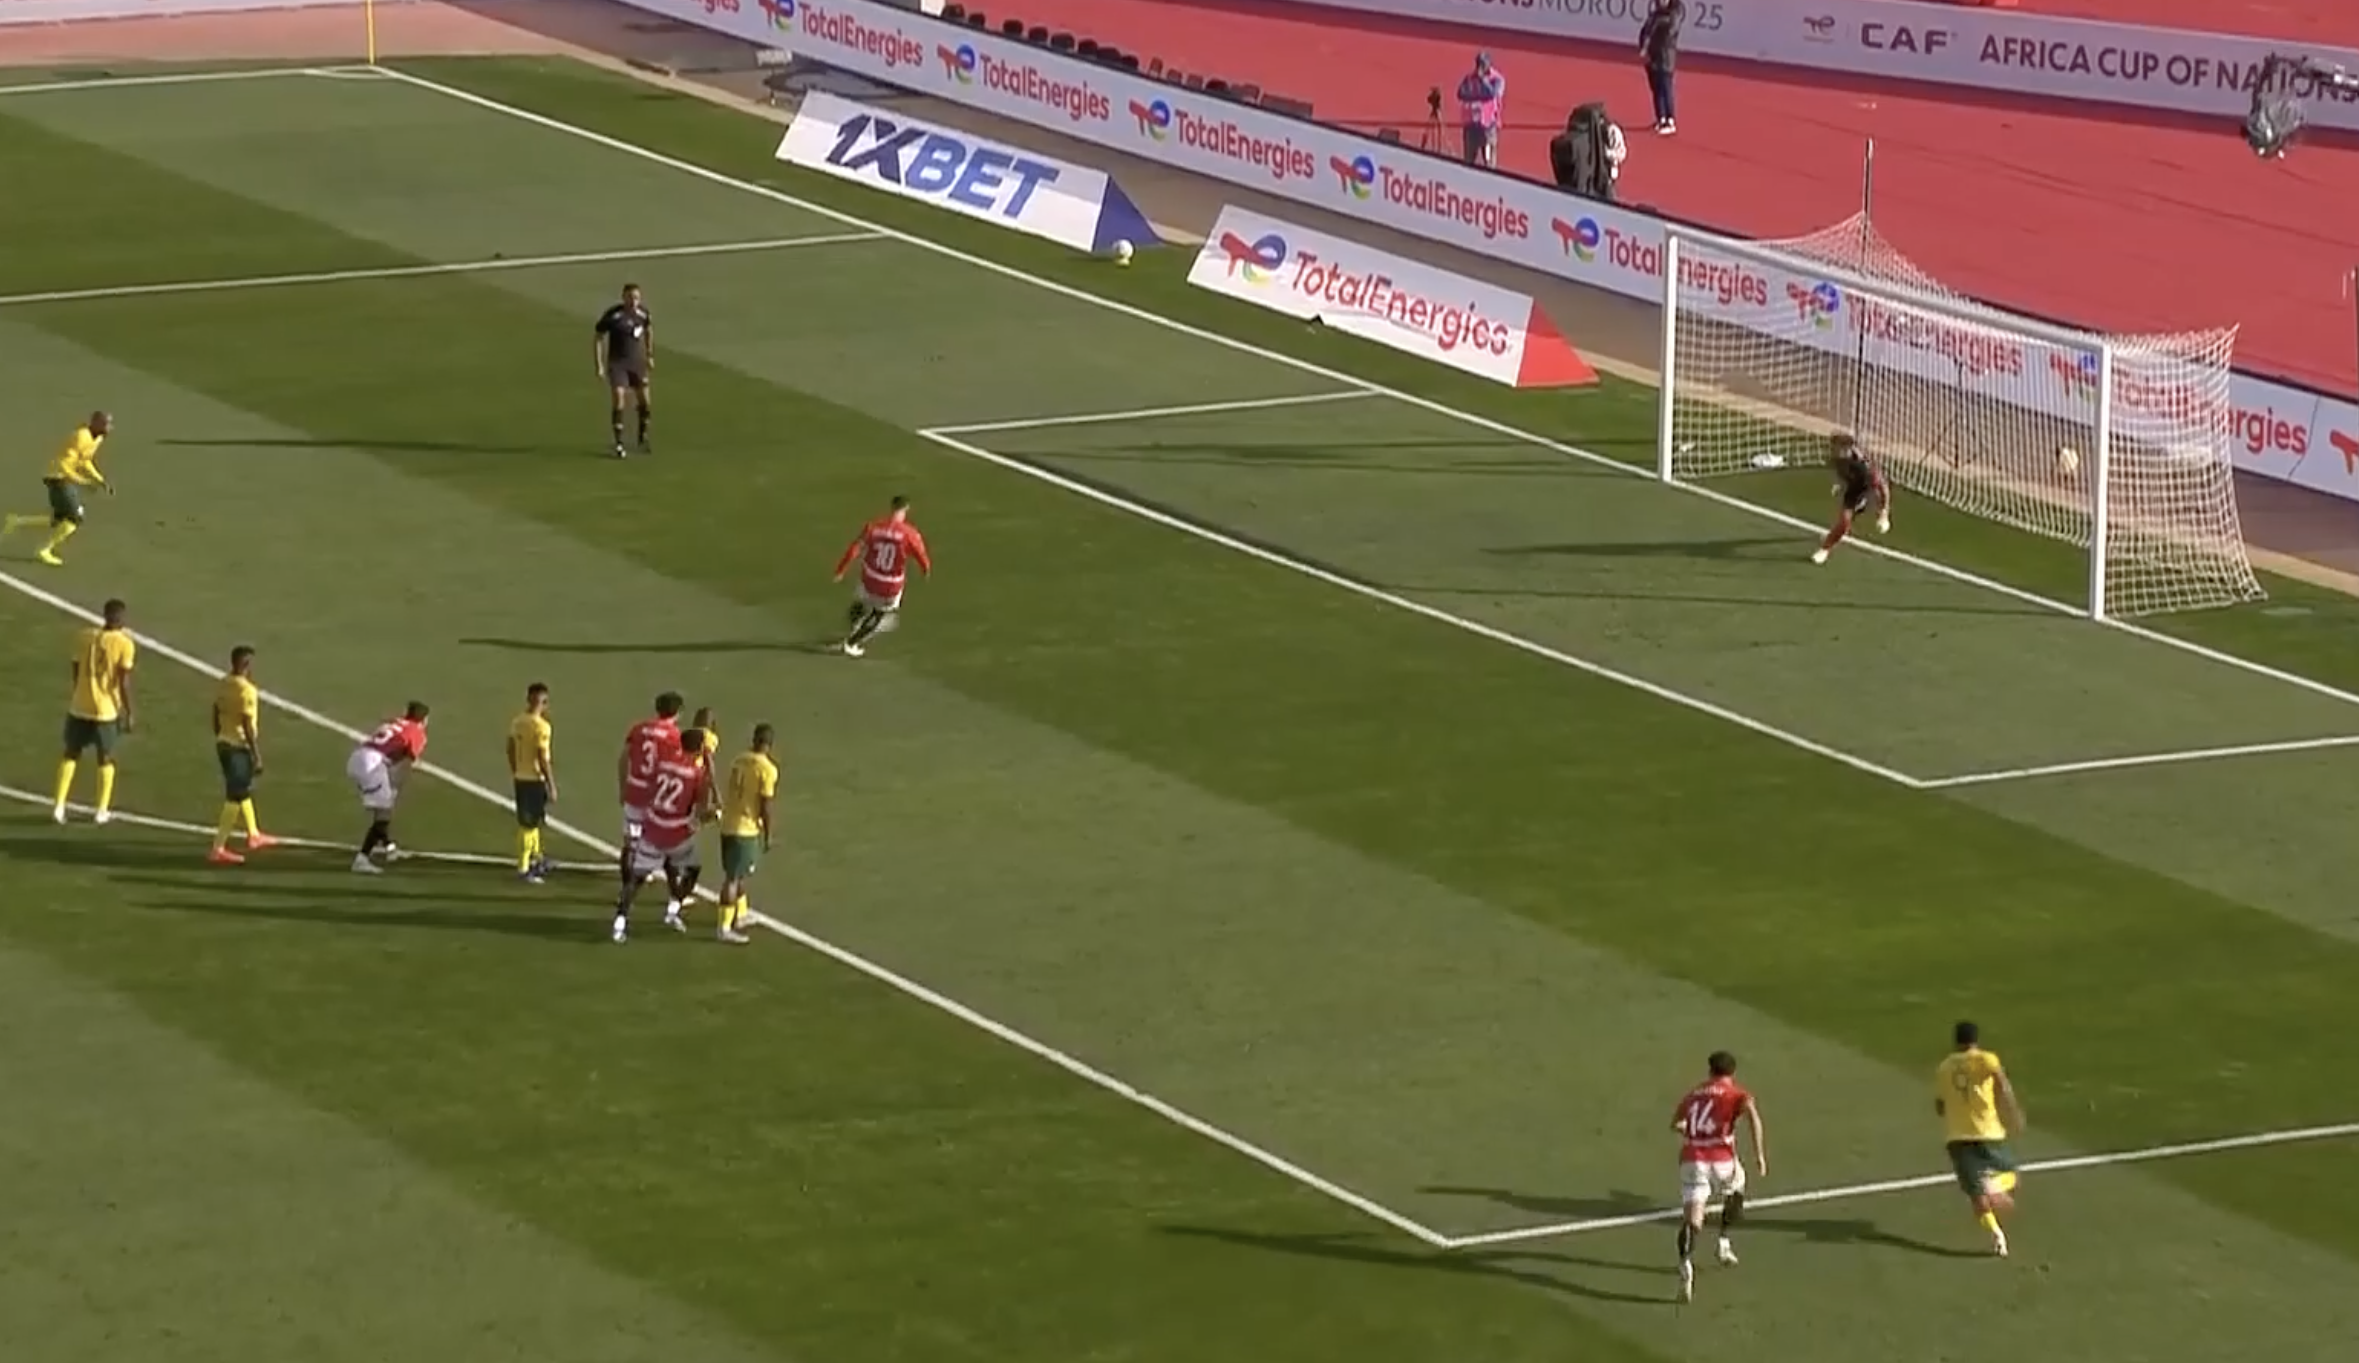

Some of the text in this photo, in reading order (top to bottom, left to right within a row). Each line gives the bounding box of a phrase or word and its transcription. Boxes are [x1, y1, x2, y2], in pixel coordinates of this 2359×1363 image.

[800, 4, 923, 68] TotalEnergies
[1694, 2, 1723, 31] 25
[1861, 22, 1947, 55] CAF
[979, 53, 1110, 121] TotalEnergies
[1979, 34, 2091, 74] AFRICA
[2099, 47, 2159, 81] CUP
[2166, 55, 2210, 87] OF
[824, 113, 1059, 219] 1XBET
[1175, 108, 1314, 179] TotalEnergies
[1379, 167, 1529, 239] TotalEnergies
[1604, 227, 1768, 306] Totalnergies
[1291, 251, 1508, 356] TotalEnergies
[873, 542, 896, 571] 10
[640, 739, 657, 776] 3
[653, 773, 685, 814] 22
[1689, 1098, 1717, 1137] 14
